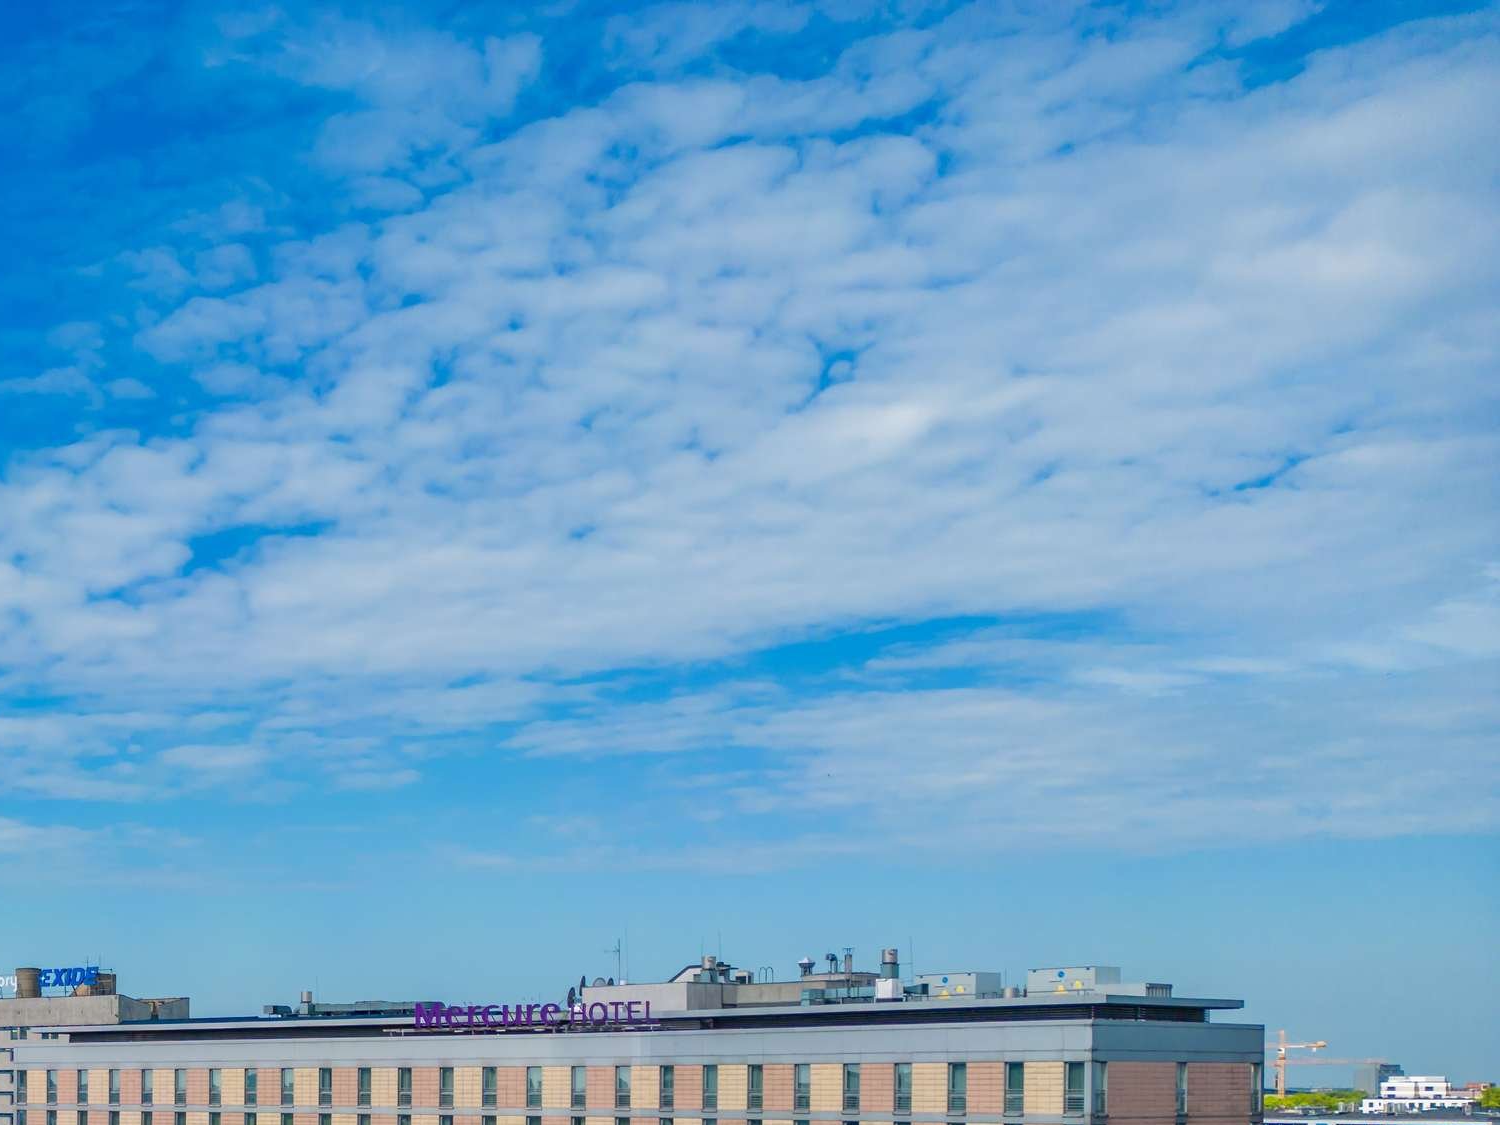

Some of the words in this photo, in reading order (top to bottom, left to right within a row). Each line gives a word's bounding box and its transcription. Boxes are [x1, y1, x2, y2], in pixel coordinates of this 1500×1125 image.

[40, 967, 99, 987] EXIDE
[414, 1001, 562, 1028] Mercure
[569, 1000, 660, 1026] HOTEL
